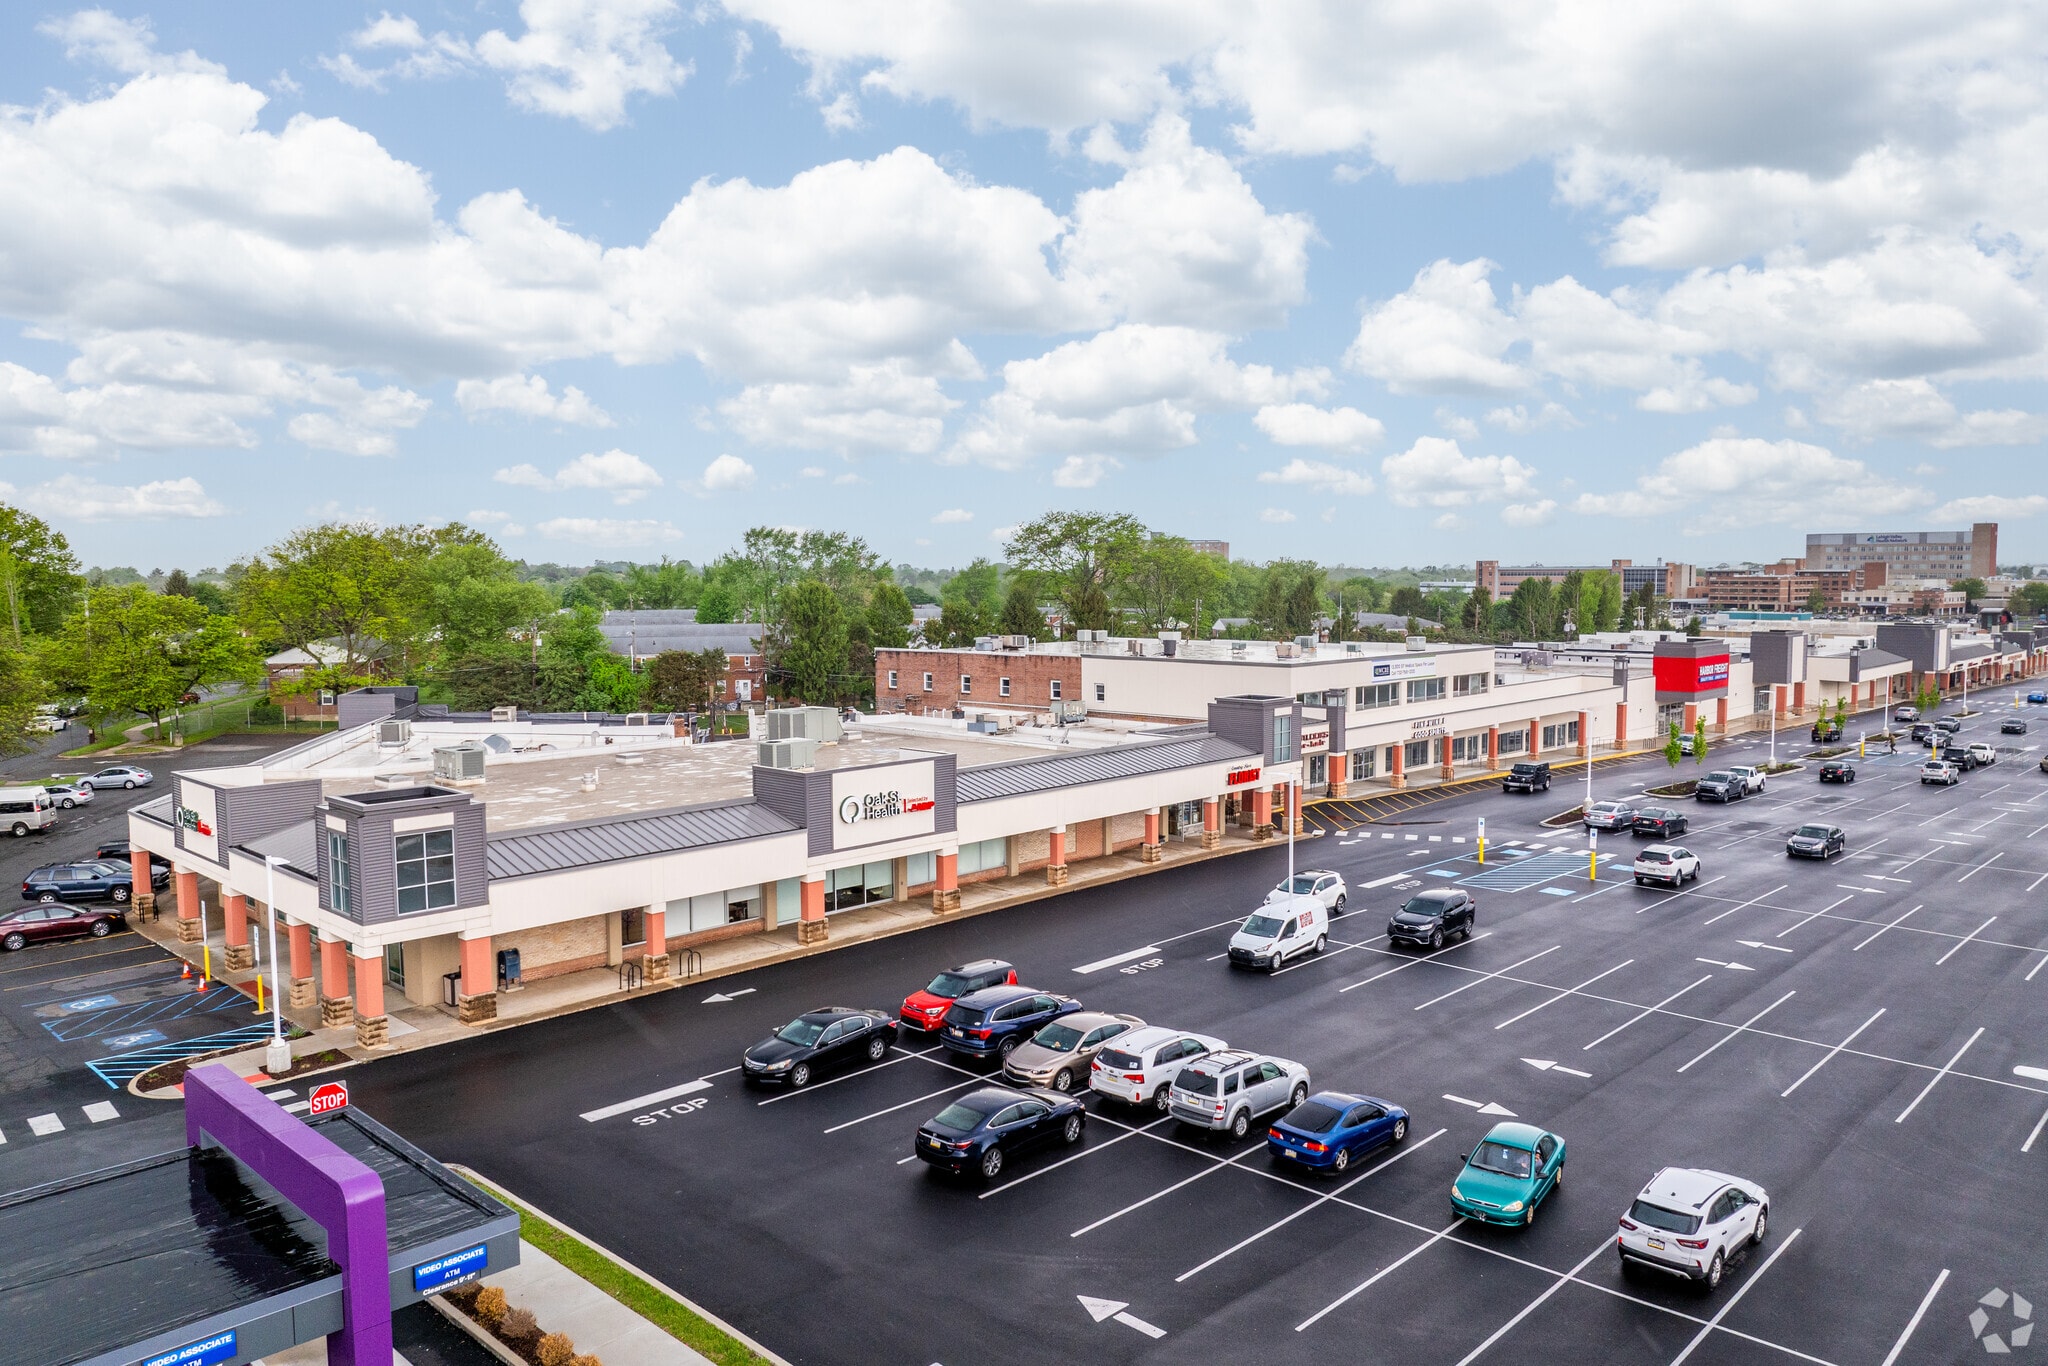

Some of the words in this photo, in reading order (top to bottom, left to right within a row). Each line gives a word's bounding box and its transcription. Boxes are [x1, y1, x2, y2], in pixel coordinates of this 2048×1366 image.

[1699, 665, 1713, 675] HARBOR
[1228, 768, 1261, 785] FLORIST
[864, 792, 887, 807] Oak
[864, 803, 902, 820] Health
[1120, 958, 1164, 974] STOP
[313, 1092, 345, 1111] STOP
[631, 1098, 708, 1126] STOP
[418, 1263, 441, 1276] VIDEO
[443, 1248, 484, 1268] ASSOCIATE
[444, 1268, 460, 1279] ATM
[423, 1280, 458, 1296] Clearance
[179, 1334, 232, 1360] ASSOCIATE
